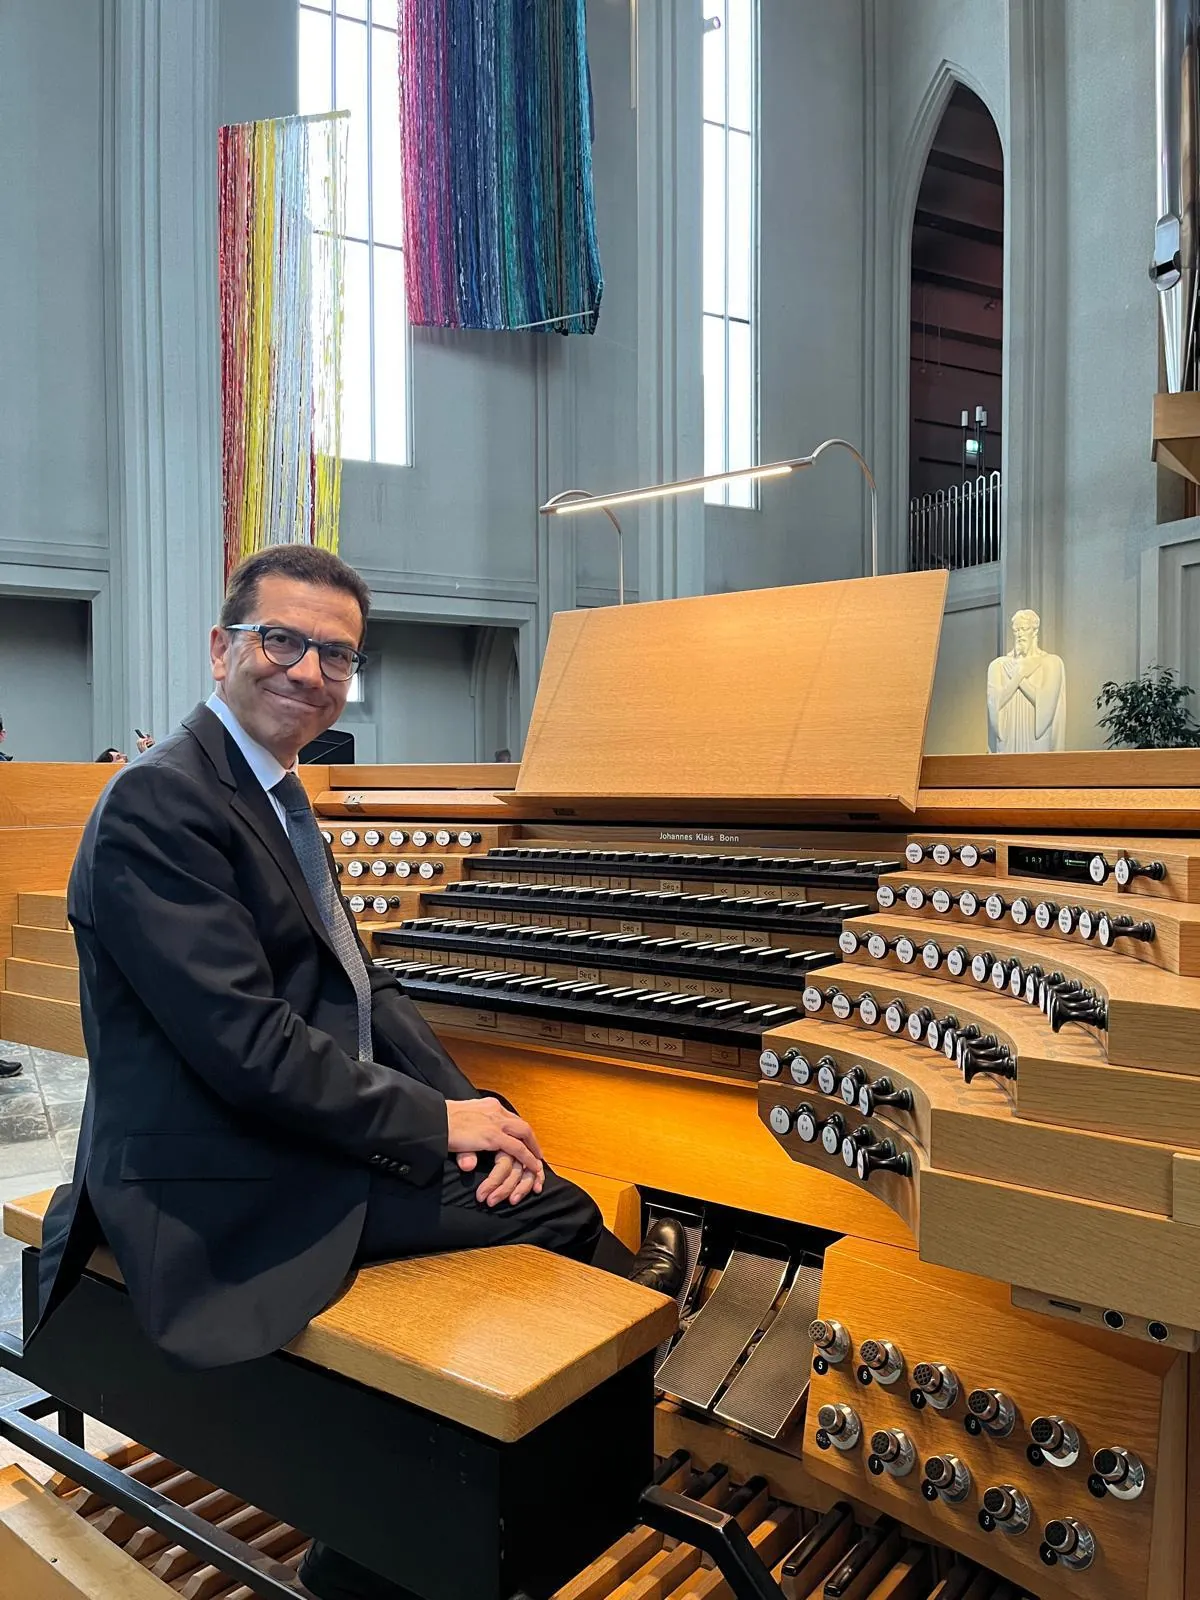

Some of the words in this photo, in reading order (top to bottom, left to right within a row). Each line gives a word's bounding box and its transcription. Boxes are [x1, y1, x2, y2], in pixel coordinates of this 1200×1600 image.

[659, 832, 692, 841] Johannes
[695, 833, 714, 841] Klais
[719, 834, 739, 842] Bonn
[818, 1361, 823, 1370] 5
[862, 1370, 868, 1380] 6
[916, 1393, 921, 1402] 7
[970, 1419, 976, 1429] 8
[874, 1460, 878, 1469] 1
[927, 1485, 933, 1495] 2
[984, 1515, 990, 1525] 3
[1046, 1549, 1051, 1558] 4
